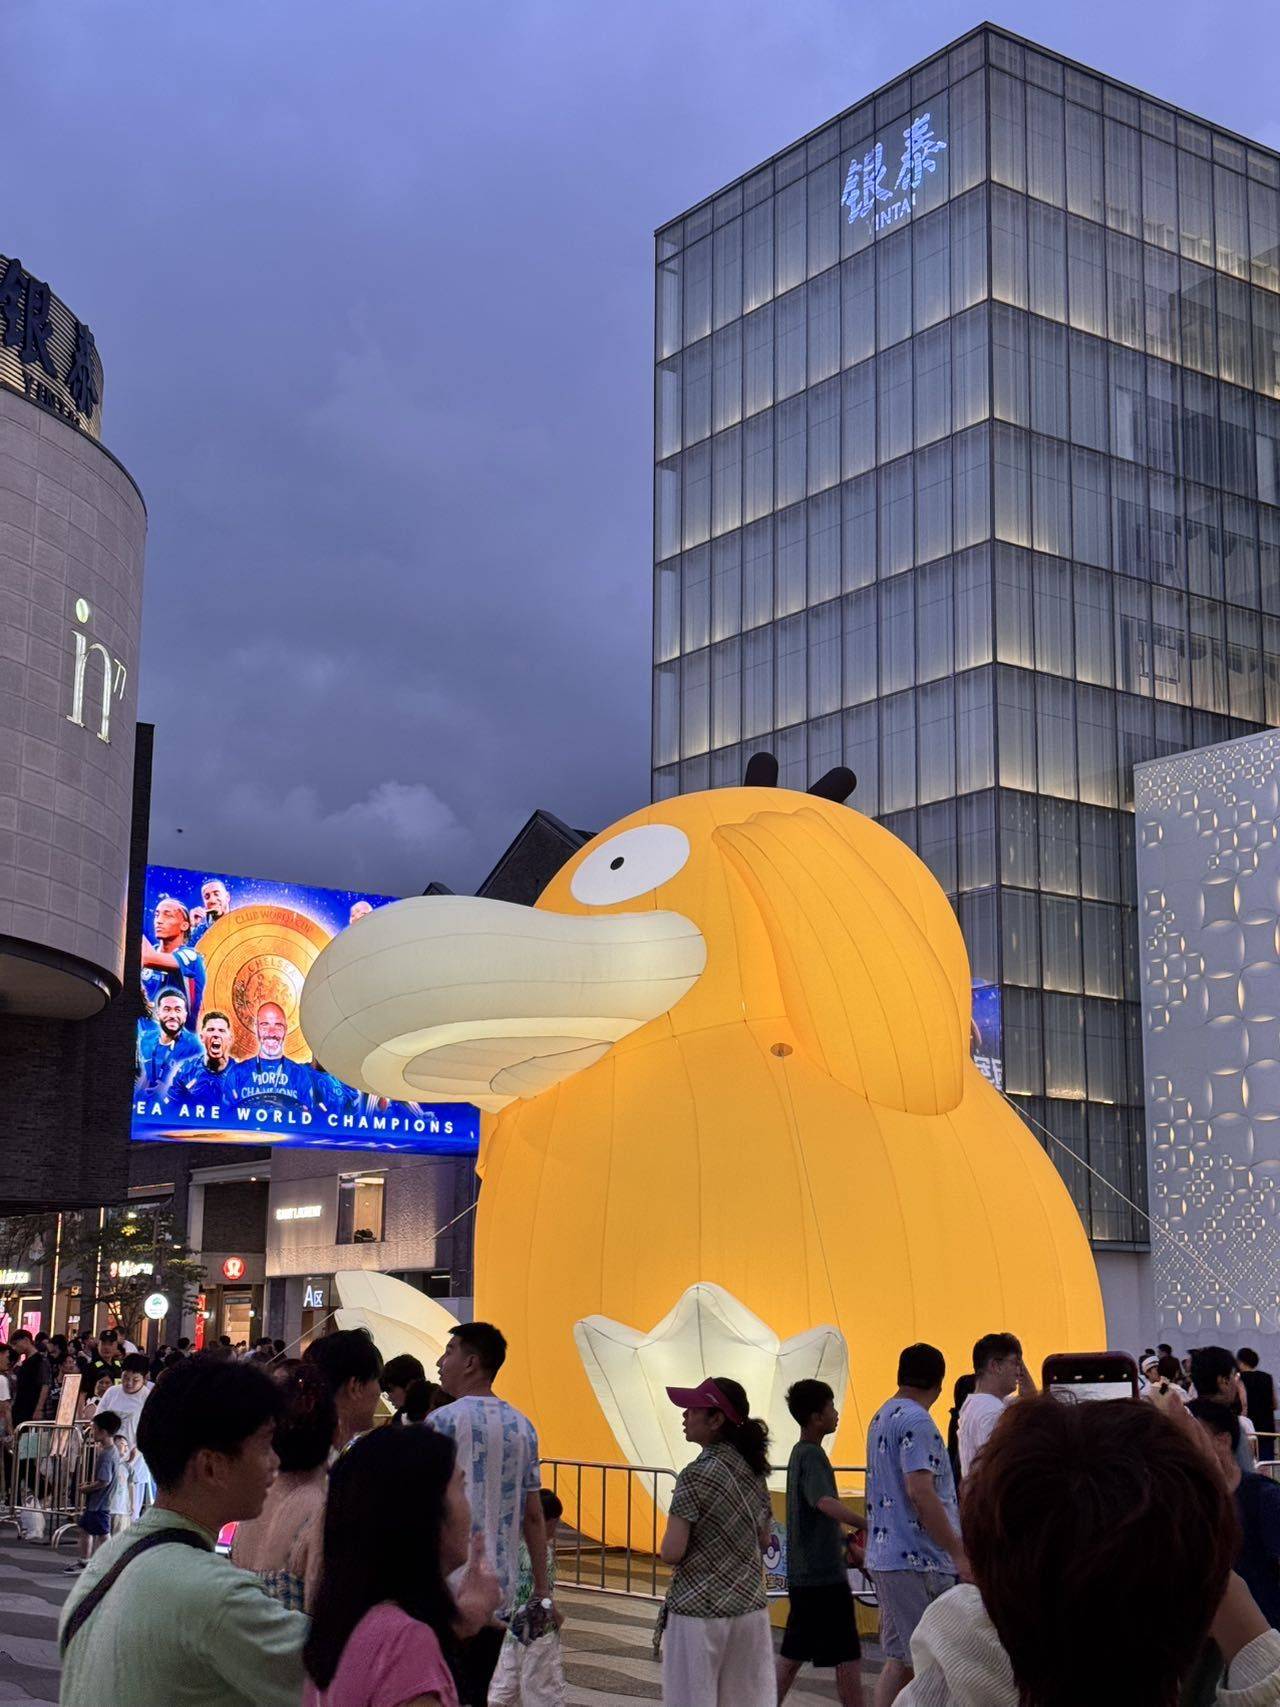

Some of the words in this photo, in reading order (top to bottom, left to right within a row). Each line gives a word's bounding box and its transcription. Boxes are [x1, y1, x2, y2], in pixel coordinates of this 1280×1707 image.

[876, 193, 916, 231] INTAI
[133, 1101, 162, 1116] EA
[179, 1104, 220, 1119] ARE
[237, 1107, 312, 1125] WORLD
[328, 1114, 454, 1134] CHAMPIONS
